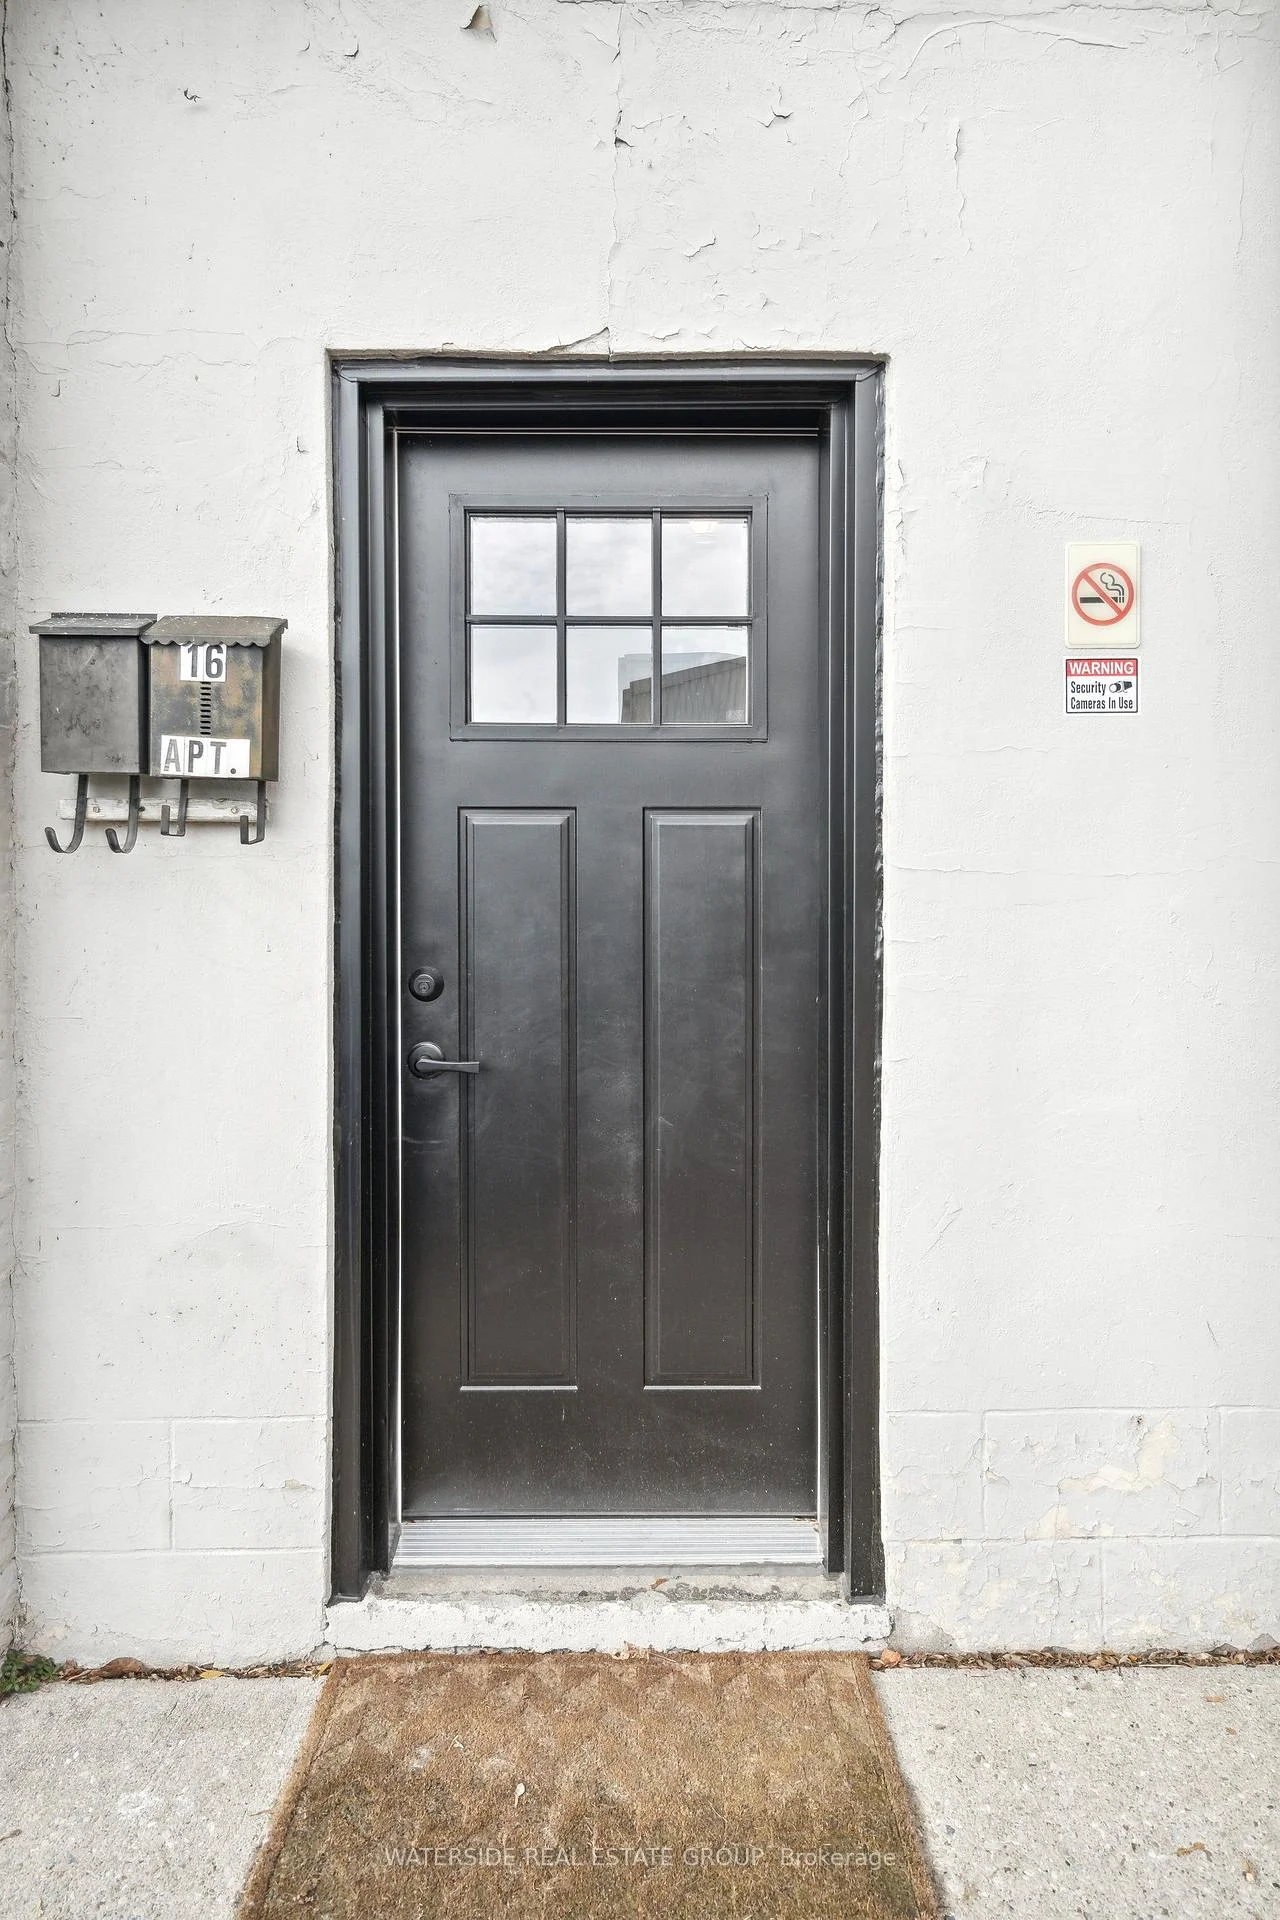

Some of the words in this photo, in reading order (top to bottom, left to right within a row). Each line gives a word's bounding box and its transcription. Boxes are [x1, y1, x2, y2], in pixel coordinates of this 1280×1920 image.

[187, 644, 224, 679] 16
[1069, 661, 1134, 675] WARNING
[1070, 681, 1107, 696] Security
[1070, 697, 1106, 709] Cameras
[1108, 697, 1116, 709] In
[1118, 697, 1133, 709] Use
[163, 738, 237, 775] APT.
